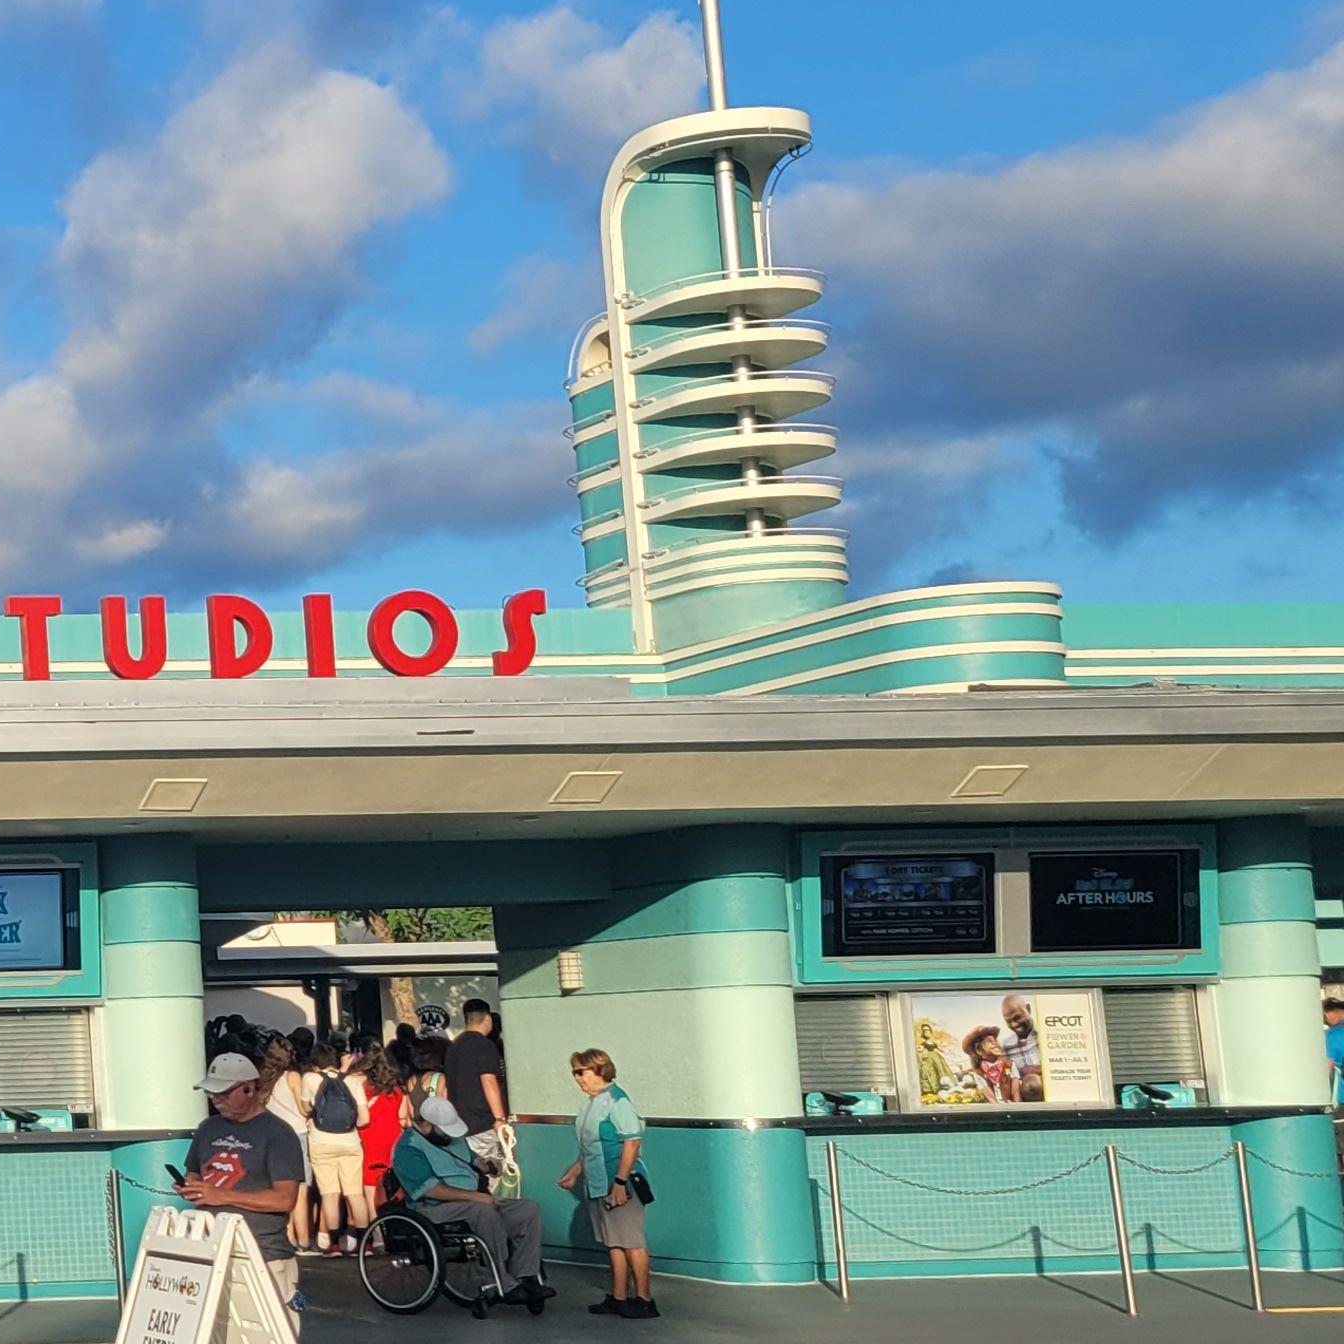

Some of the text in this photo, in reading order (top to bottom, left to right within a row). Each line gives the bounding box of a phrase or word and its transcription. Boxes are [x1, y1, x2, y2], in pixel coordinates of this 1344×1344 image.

[1056, 891, 1154, 905] AFTER HOURS
[1045, 1016, 1083, 1027] EPCOT
[147, 1308, 181, 1336] EARLY
